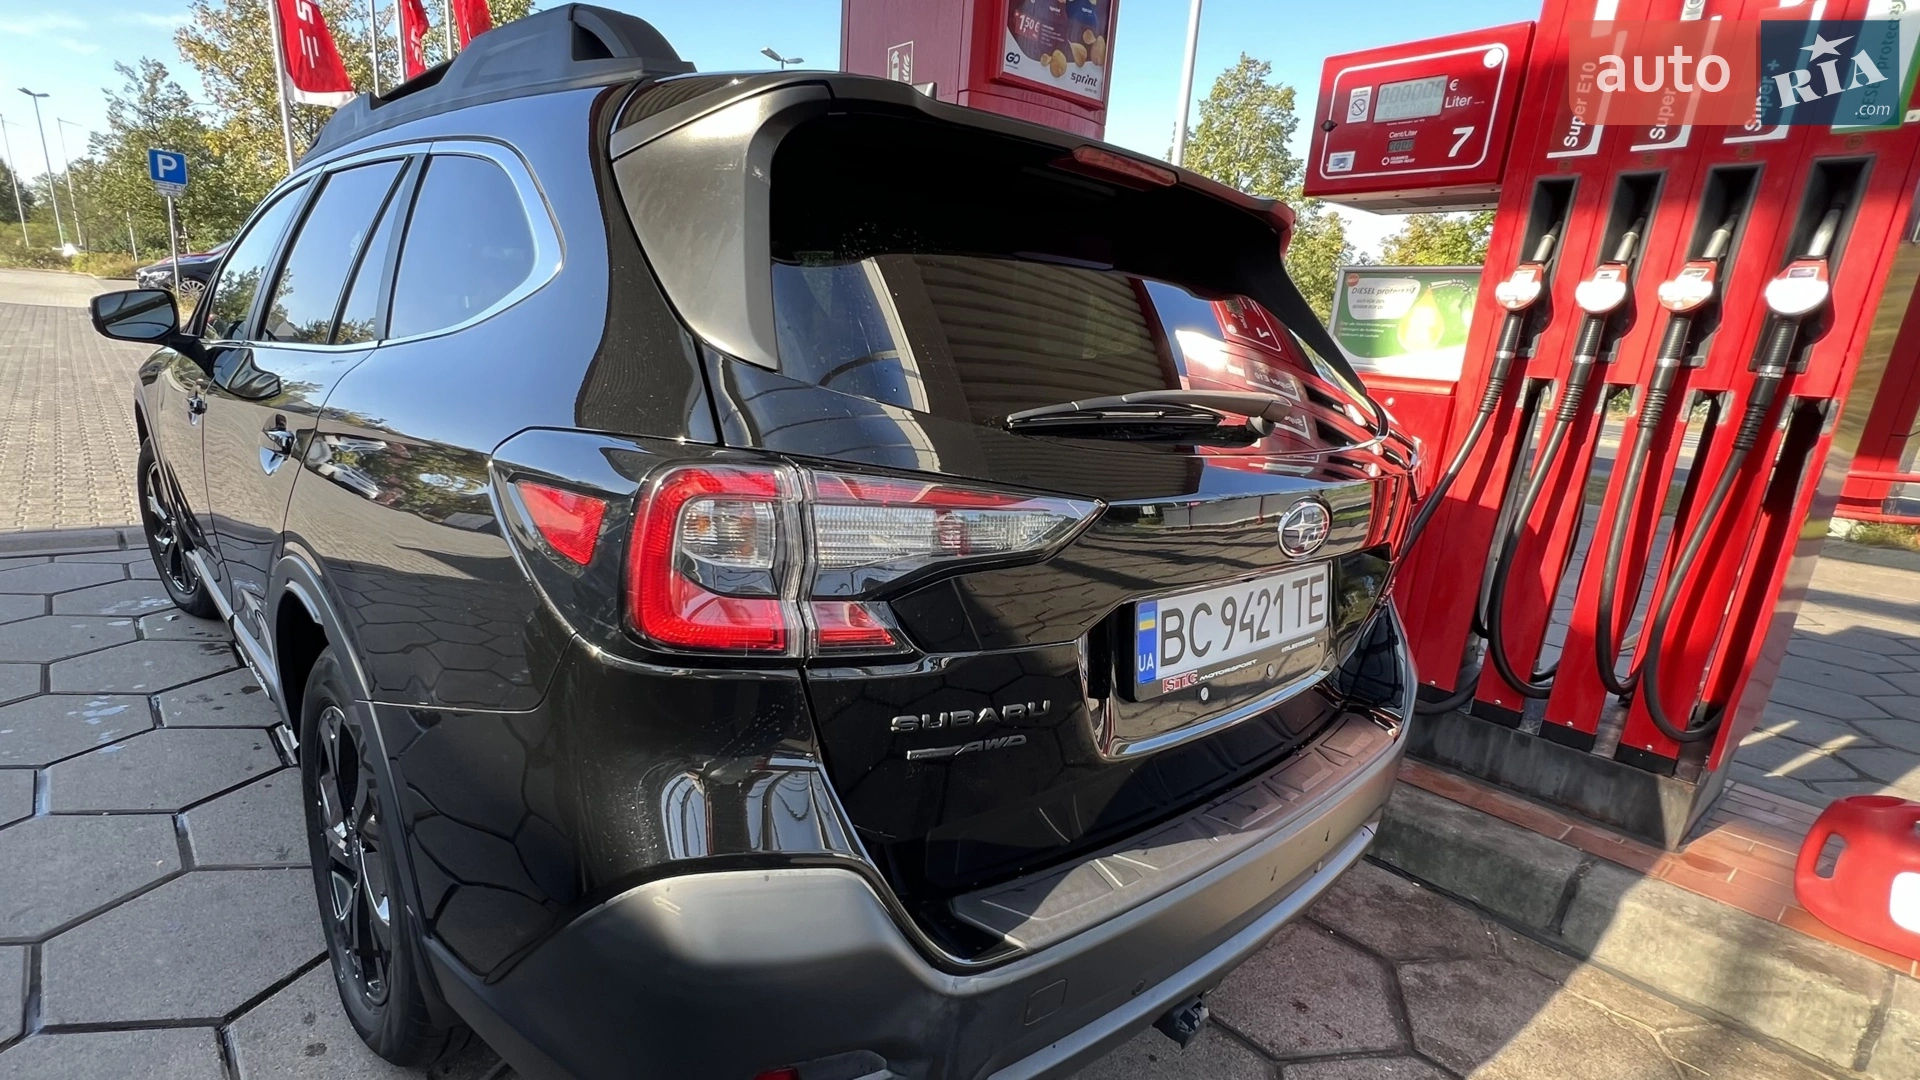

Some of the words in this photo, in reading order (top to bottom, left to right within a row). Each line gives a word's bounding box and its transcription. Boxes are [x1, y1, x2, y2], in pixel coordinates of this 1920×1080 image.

[1070, 71, 1099, 88] sprint
[1449, 78, 1460, 92] €
[1445, 96, 1473, 109] Liter
[1563, 97, 1588, 148] Super
[1576, 61, 1597, 94] E10
[1649, 87, 1677, 140] Super
[1448, 125, 1476, 158] 7
[157, 154, 178, 178] P
[1351, 287, 1376, 295] DIESEL
[1159, 602, 1213, 668] BC
[1220, 583, 1285, 652] 9421
[1292, 573, 1325, 629] TE
[1138, 652, 1155, 672] UA
[1199, 658, 1258, 682] MOTORSPORT
[890, 699, 1051, 732] SUBARU
[956, 734, 1028, 755] AWD
